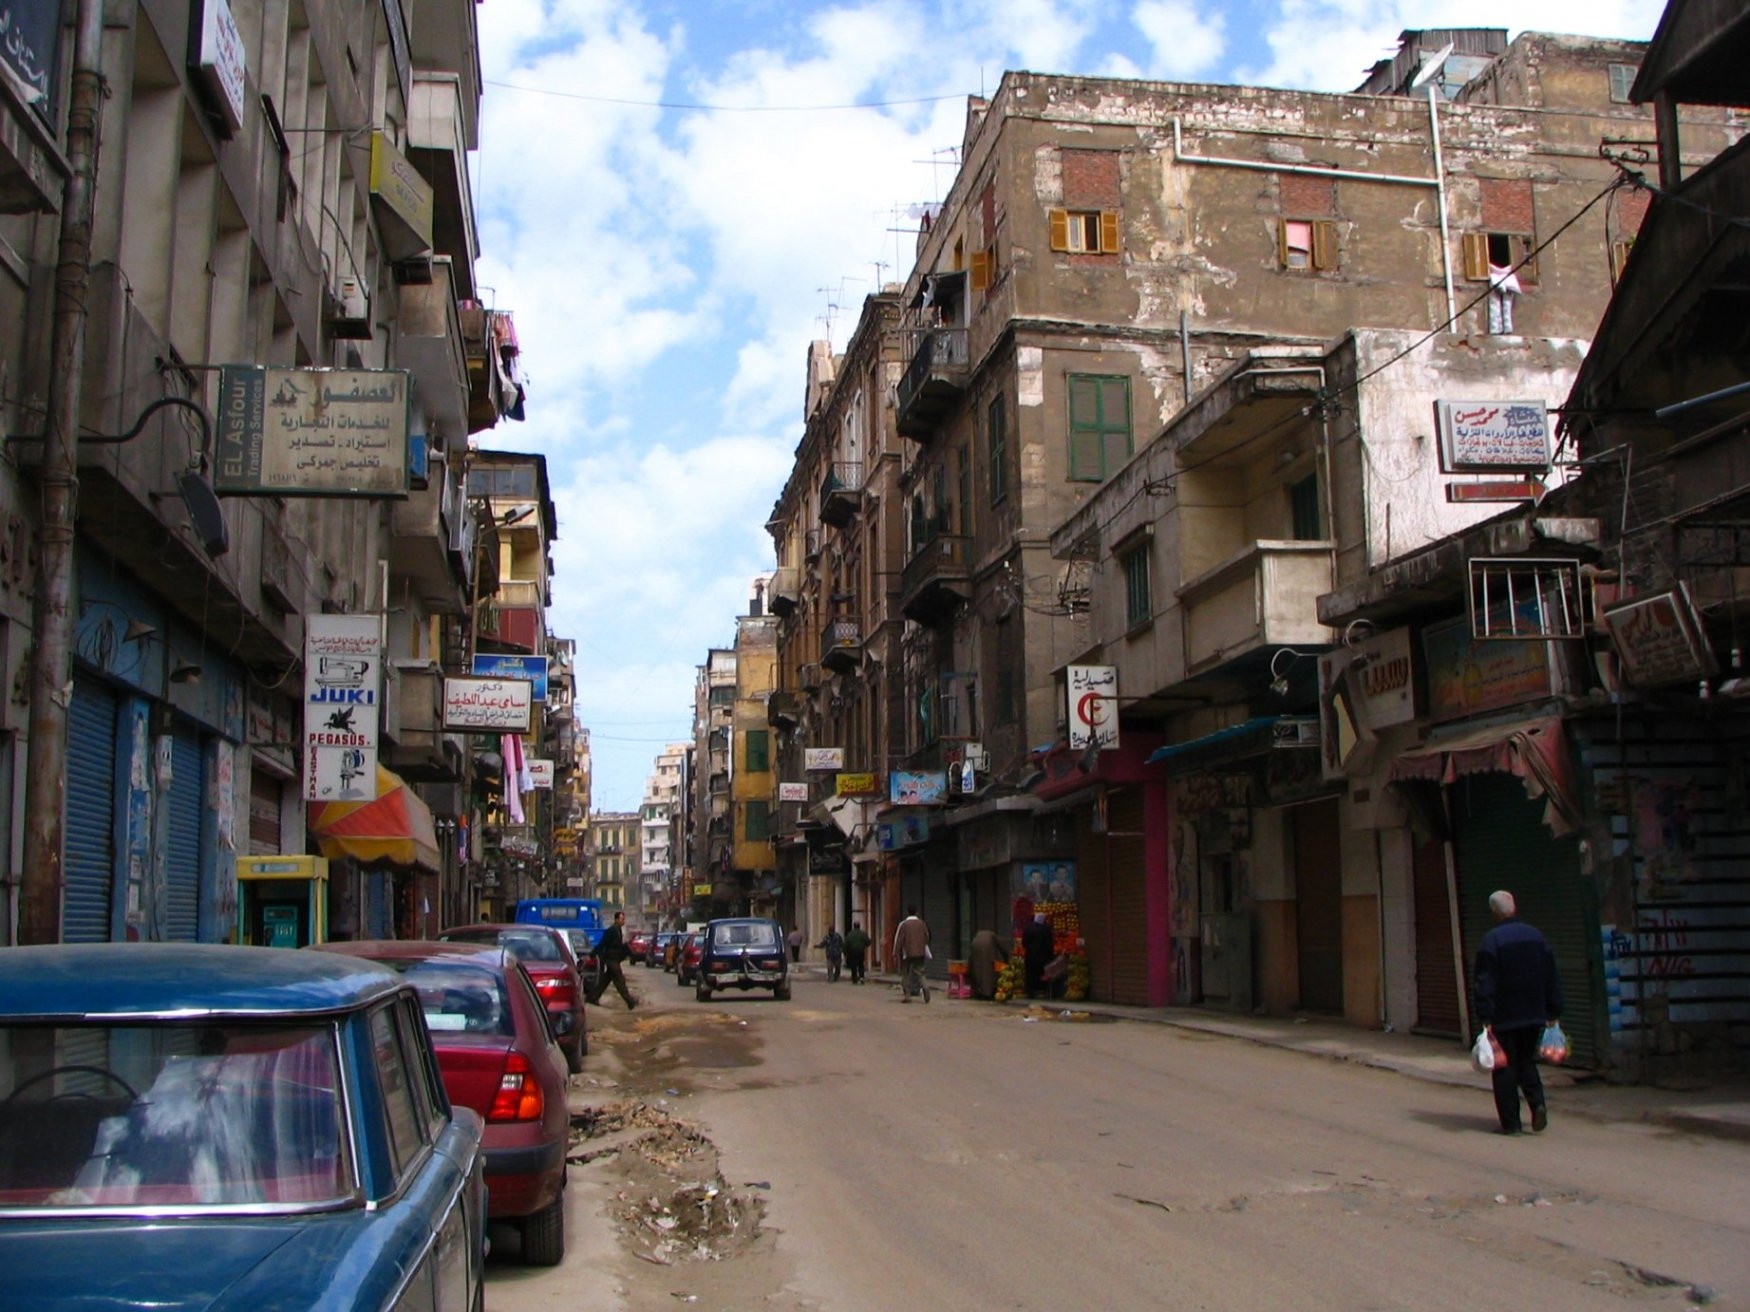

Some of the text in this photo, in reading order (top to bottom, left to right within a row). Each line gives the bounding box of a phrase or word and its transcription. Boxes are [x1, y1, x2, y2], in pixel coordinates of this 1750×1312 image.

[225, 378, 246, 445] Asfour
[1455, 407, 1486, 423] حسن
[1469, 408, 1499, 426] محمد
[247, 378, 263, 477] Trading Services
[280, 411, 390, 432] للخدمات التجارية
[340, 456, 380, 471] تخليص
[476, 682, 503, 693] دكتور
[1072, 669, 1114, 691] صيدلية
[310, 688, 374, 704] JUKI
[309, 746, 318, 799] EASTMAN
